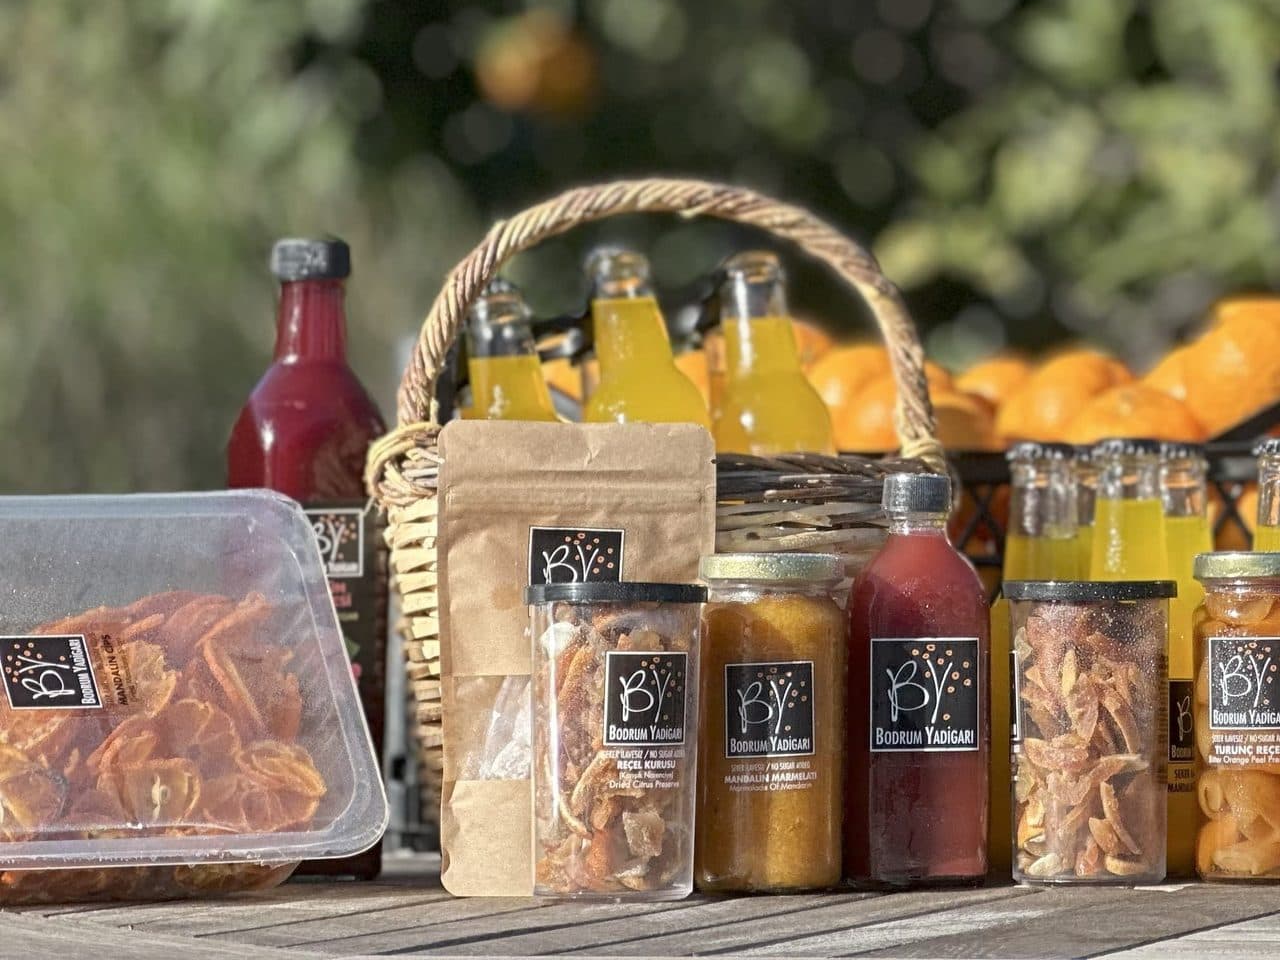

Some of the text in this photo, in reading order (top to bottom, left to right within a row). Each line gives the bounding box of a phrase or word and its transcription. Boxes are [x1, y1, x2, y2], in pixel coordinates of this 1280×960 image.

[17, 654, 76, 700] BY
[1219, 654, 1271, 708] BY
[78, 673, 97, 704] BODRUM
[619, 669, 672, 723] BY
[886, 659, 953, 724] BY
[737, 680, 792, 734] BY
[1213, 709, 1247, 725] BODRUM
[609, 724, 648, 741] BODRUM
[876, 725, 974, 745] BODRUM YADİGARI
[730, 737, 768, 753] BODRUM
[1214, 745, 1254, 756] TURUNÇ
[617, 759, 676, 771] REÇEL KURUSU
[1223, 755, 1249, 765] Orange
